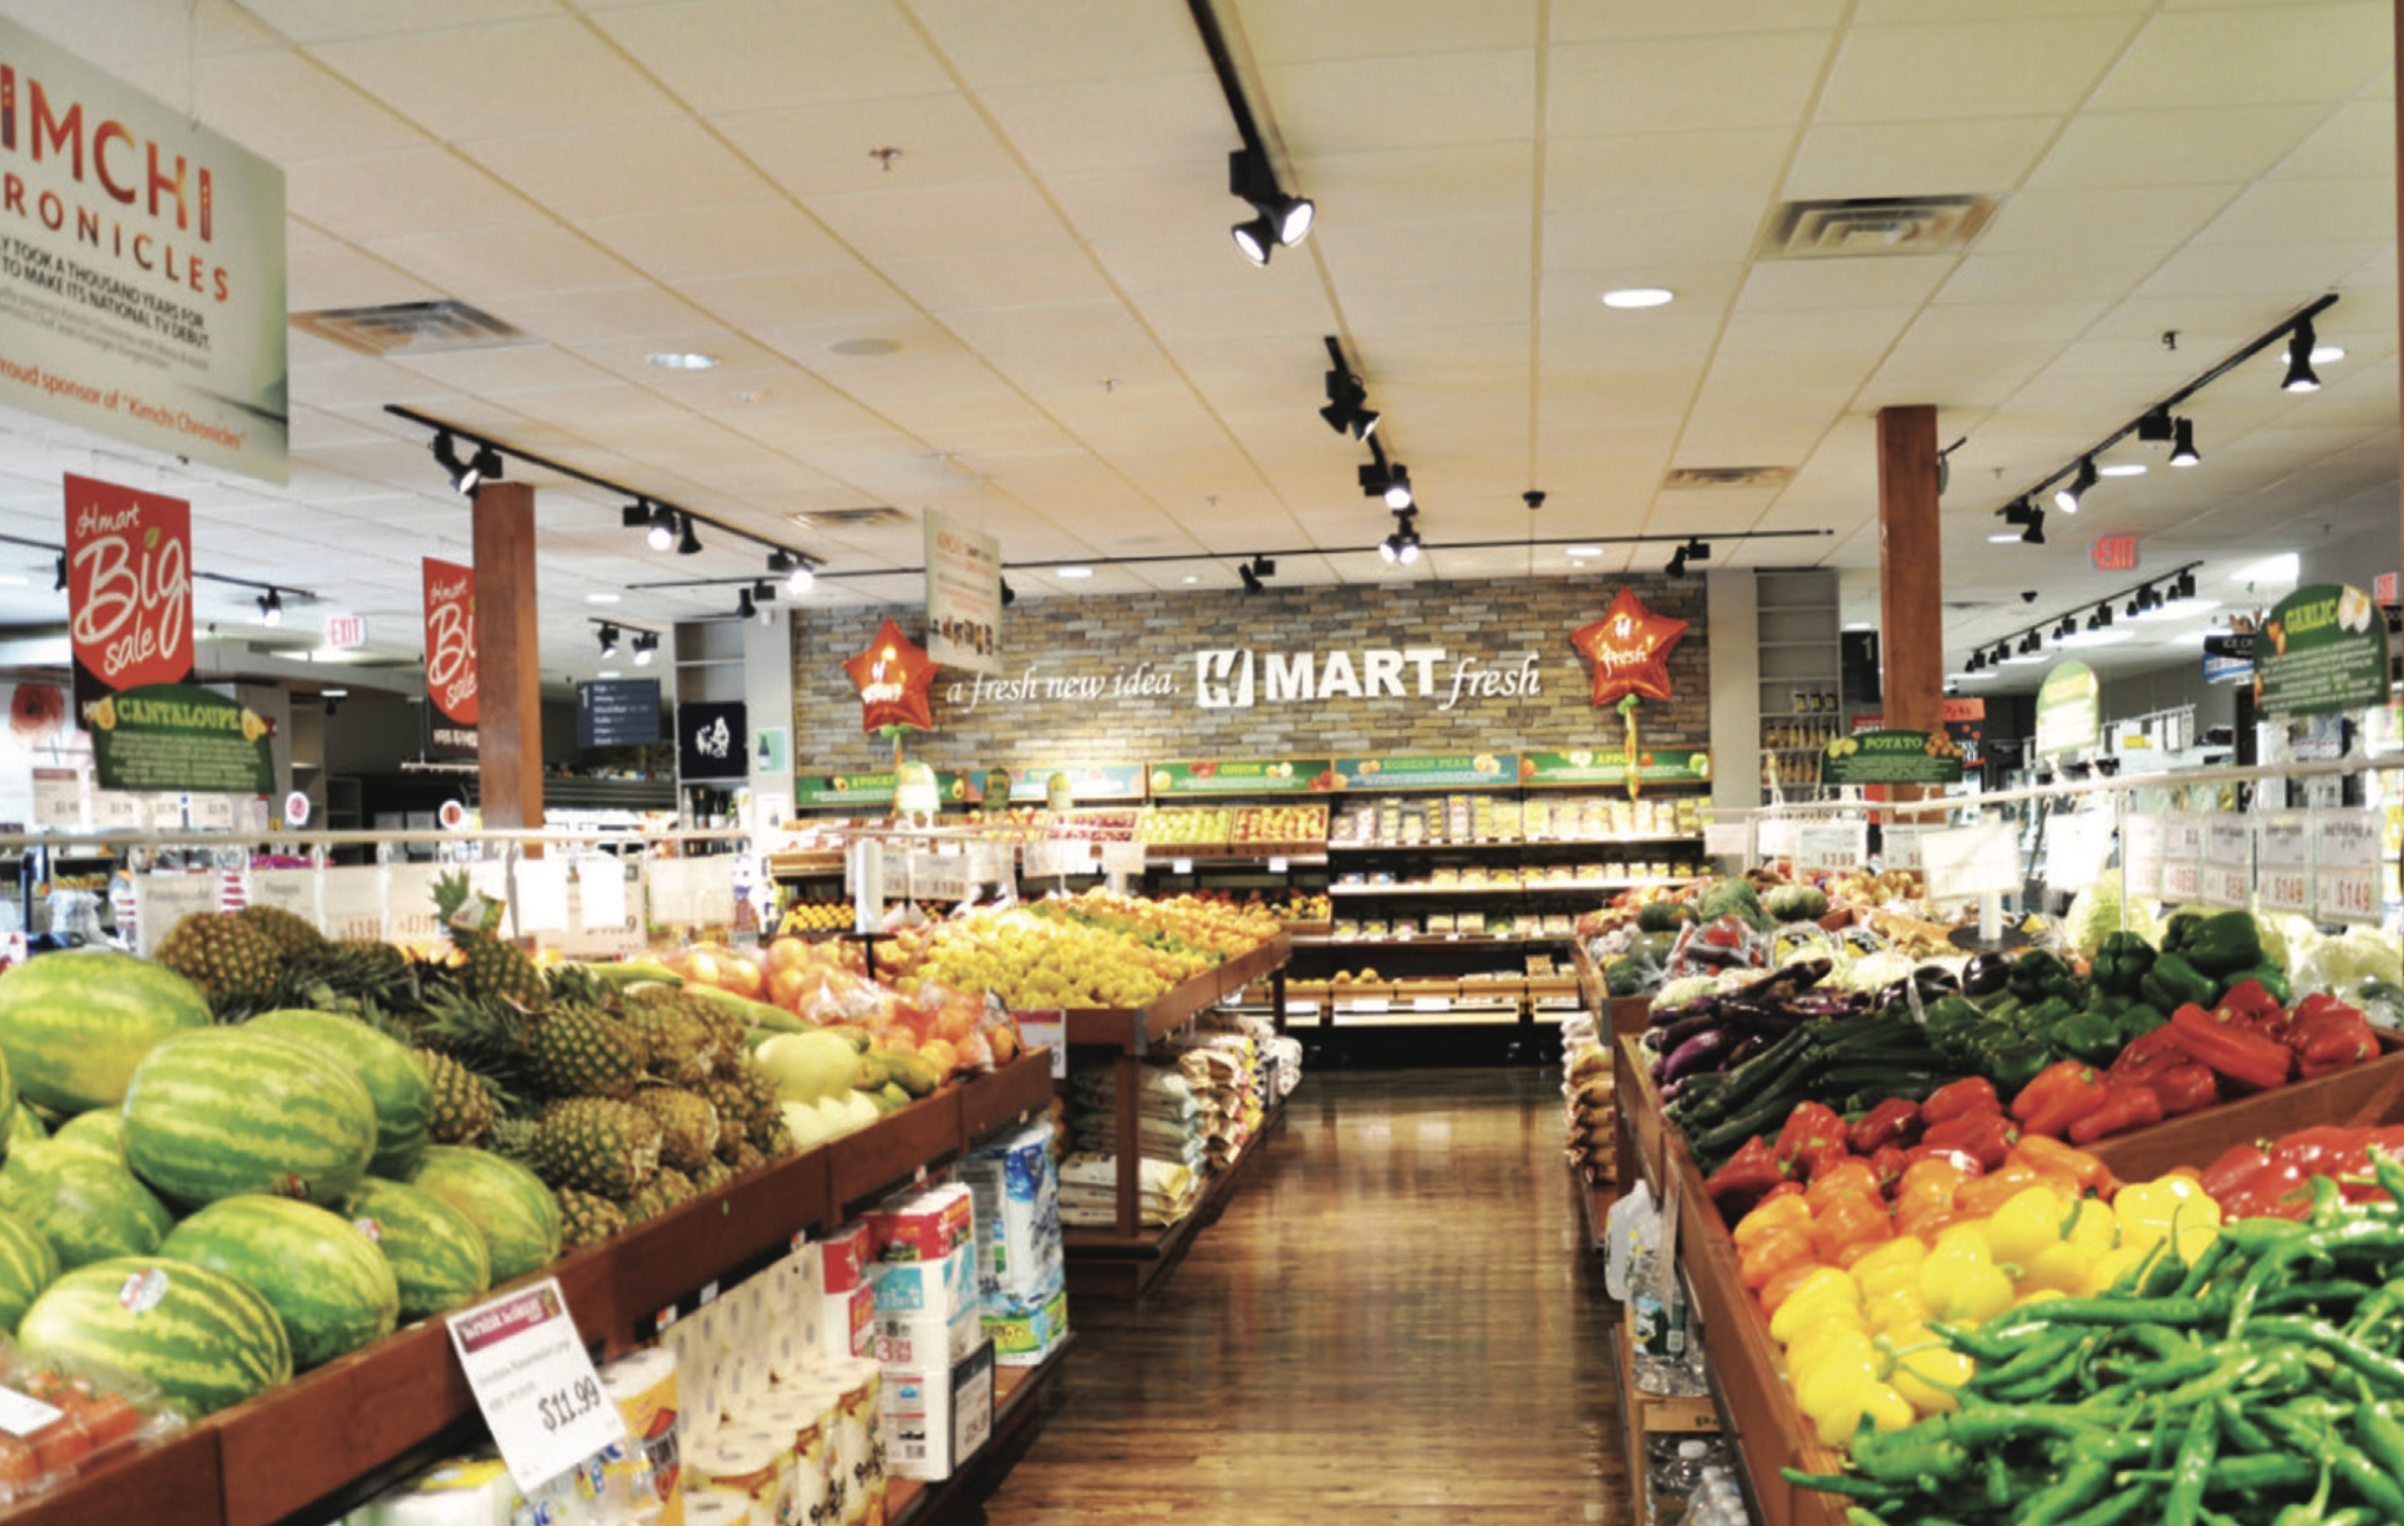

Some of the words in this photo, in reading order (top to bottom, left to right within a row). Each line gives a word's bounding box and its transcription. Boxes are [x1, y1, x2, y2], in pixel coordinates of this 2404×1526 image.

[2, 256, 21, 278] TO
[24, 266, 63, 296] MAKE
[66, 283, 87, 304] ITS
[89, 291, 152, 330] NATIONAL
[154, 316, 169, 335] TV
[14, 239, 52, 267] TOOK
[56, 258, 65, 274] A
[68, 260, 140, 304] THOUSAND
[143, 293, 179, 321] YEARS
[181, 308, 206, 328] FOR
[42, 371, 101, 406] sponsor
[104, 387, 119, 411] of
[2098, 537, 2135, 570] EXIT
[72, 527, 191, 660] Big
[331, 617, 361, 647] EXIT
[2285, 598, 2338, 635] GARLIC
[103, 611, 157, 677] sale
[428, 595, 477, 686] Bi
[1861, 635, 1873, 661] 1
[578, 686, 589, 709] 1
[946, 681, 962, 702] a
[962, 663, 1037, 713] fresh
[1047, 674, 1106, 702] new
[1112, 661, 1182, 697] idea.
[1265, 647, 1446, 701] MART
[1438, 653, 1541, 710] fresh
[117, 700, 241, 731] CANTALOUPE
[1865, 737, 1923, 749] POTATO
[1221, 764, 1261, 775] ONION
[1438, 757, 1470, 770] PEAR
[538, 1375, 601, 1432] $11.99
